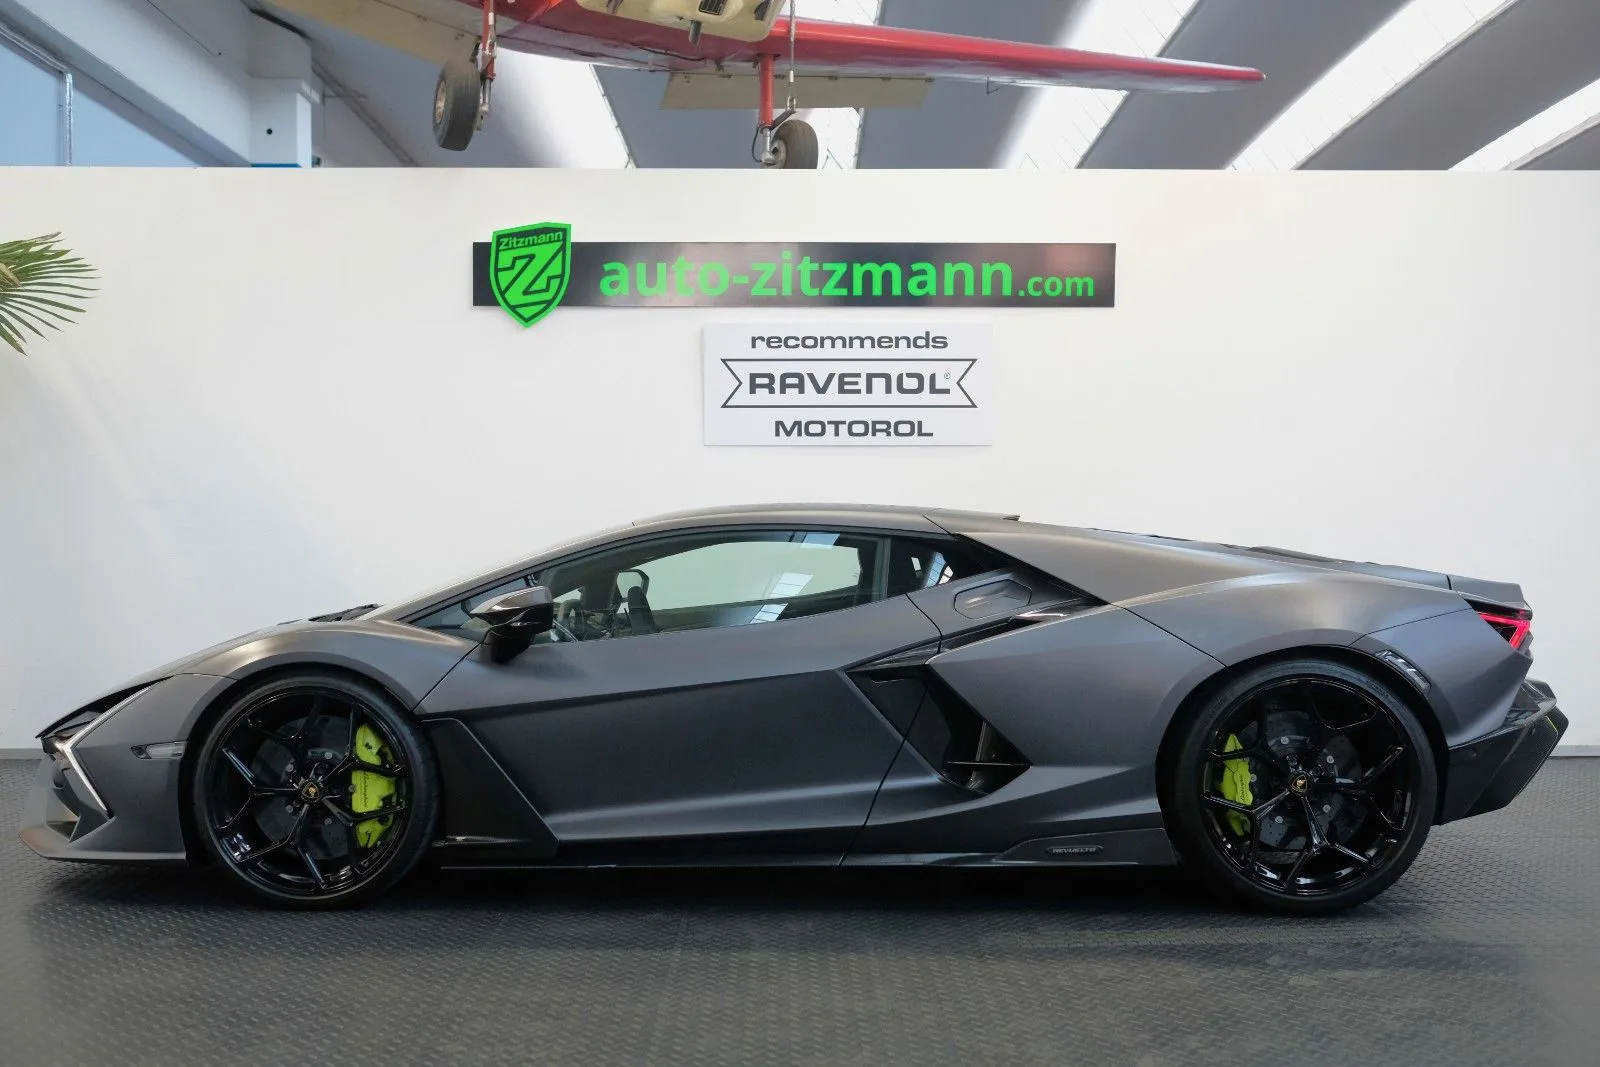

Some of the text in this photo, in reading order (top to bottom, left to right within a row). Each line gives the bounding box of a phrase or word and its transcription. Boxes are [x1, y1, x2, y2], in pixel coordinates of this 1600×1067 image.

[499, 231, 563, 250] Zitzmann
[599, 251, 1095, 297] auto-zitzmann.com
[751, 330, 949, 349] recommends
[774, 420, 934, 437] MOTOROL
